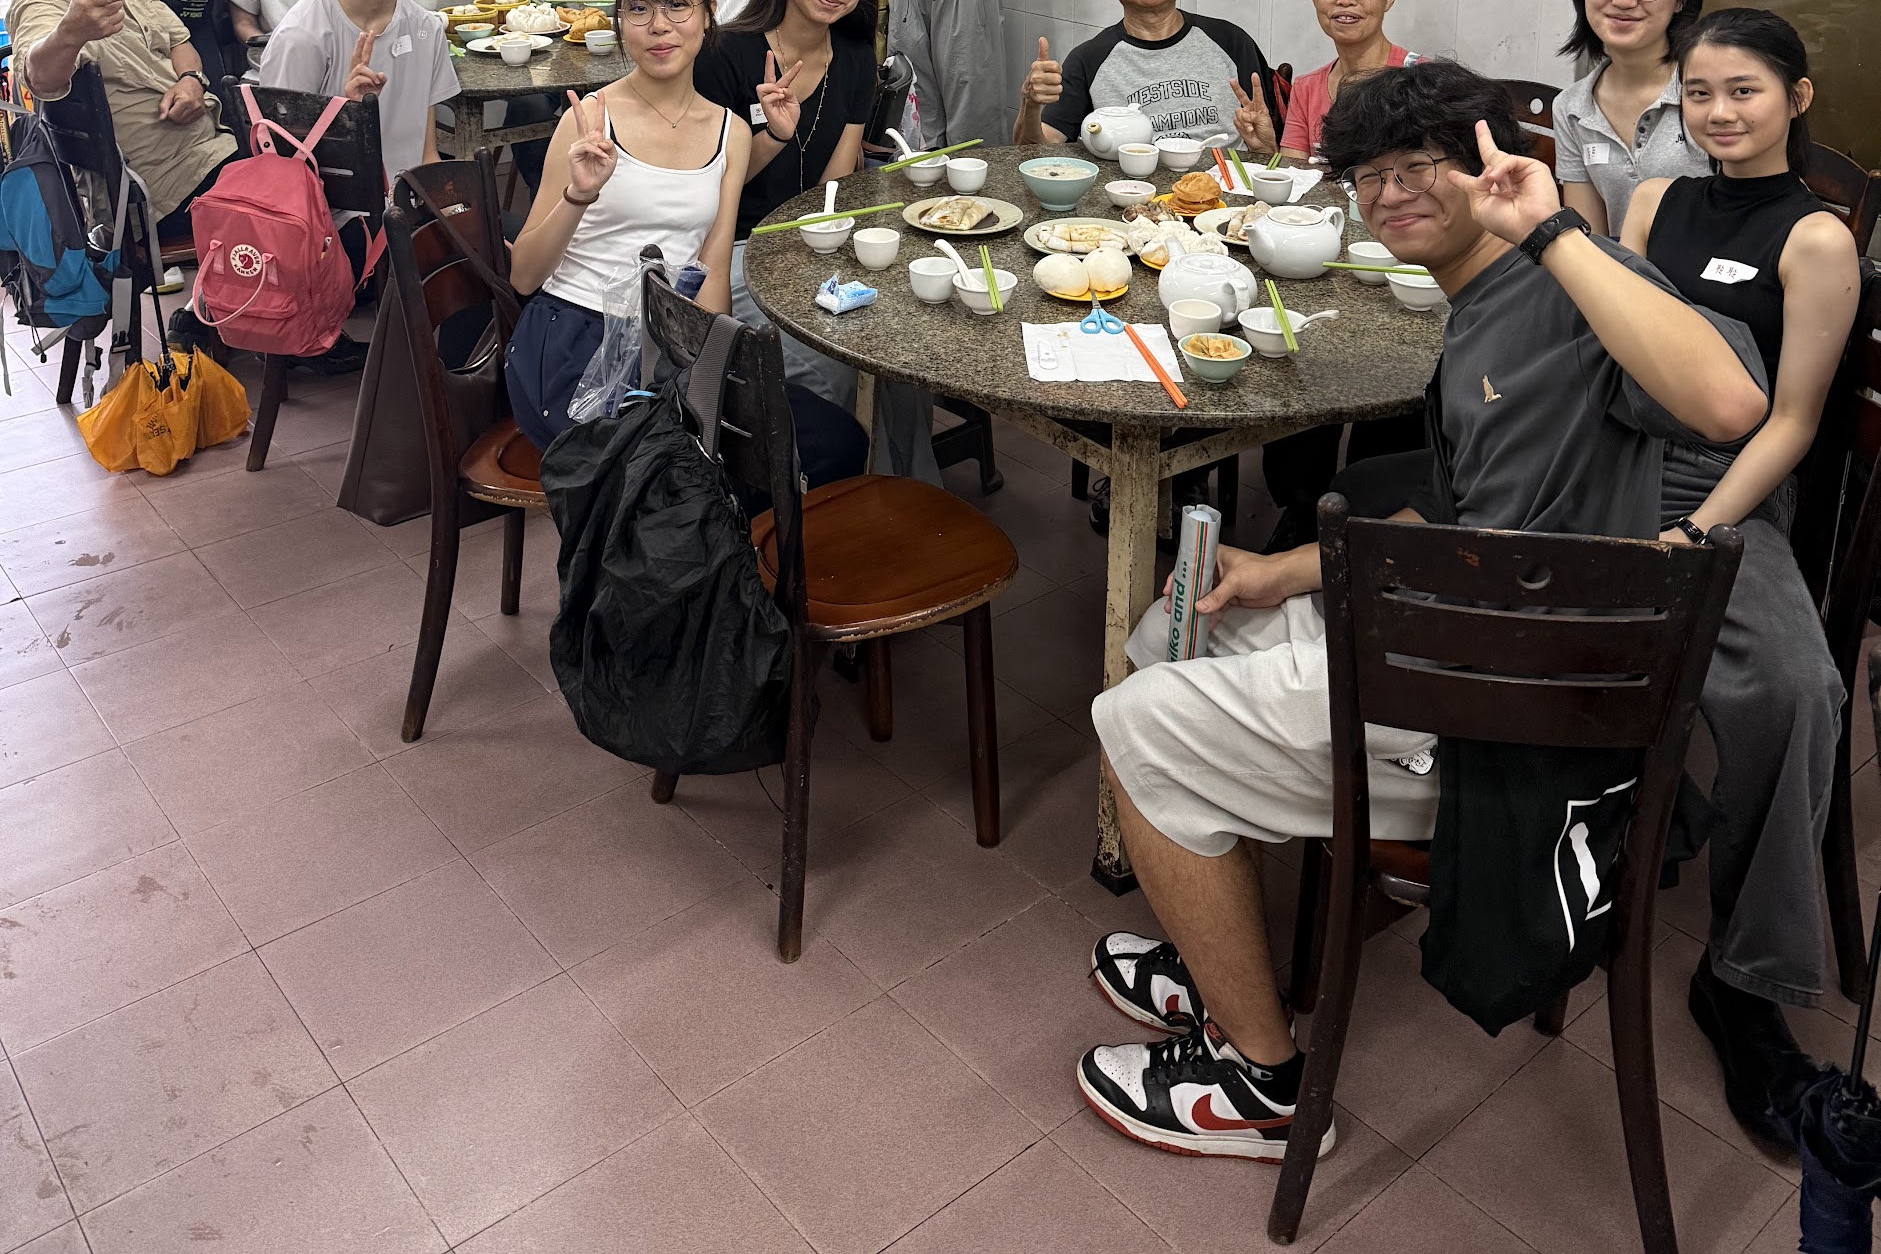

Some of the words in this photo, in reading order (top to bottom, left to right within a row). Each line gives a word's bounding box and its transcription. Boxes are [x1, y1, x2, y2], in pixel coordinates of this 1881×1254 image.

[1127, 79, 1212, 107] WESTSIDE
[1150, 106, 1219, 132] AMPIONS
[1174, 578, 1185, 623] and
